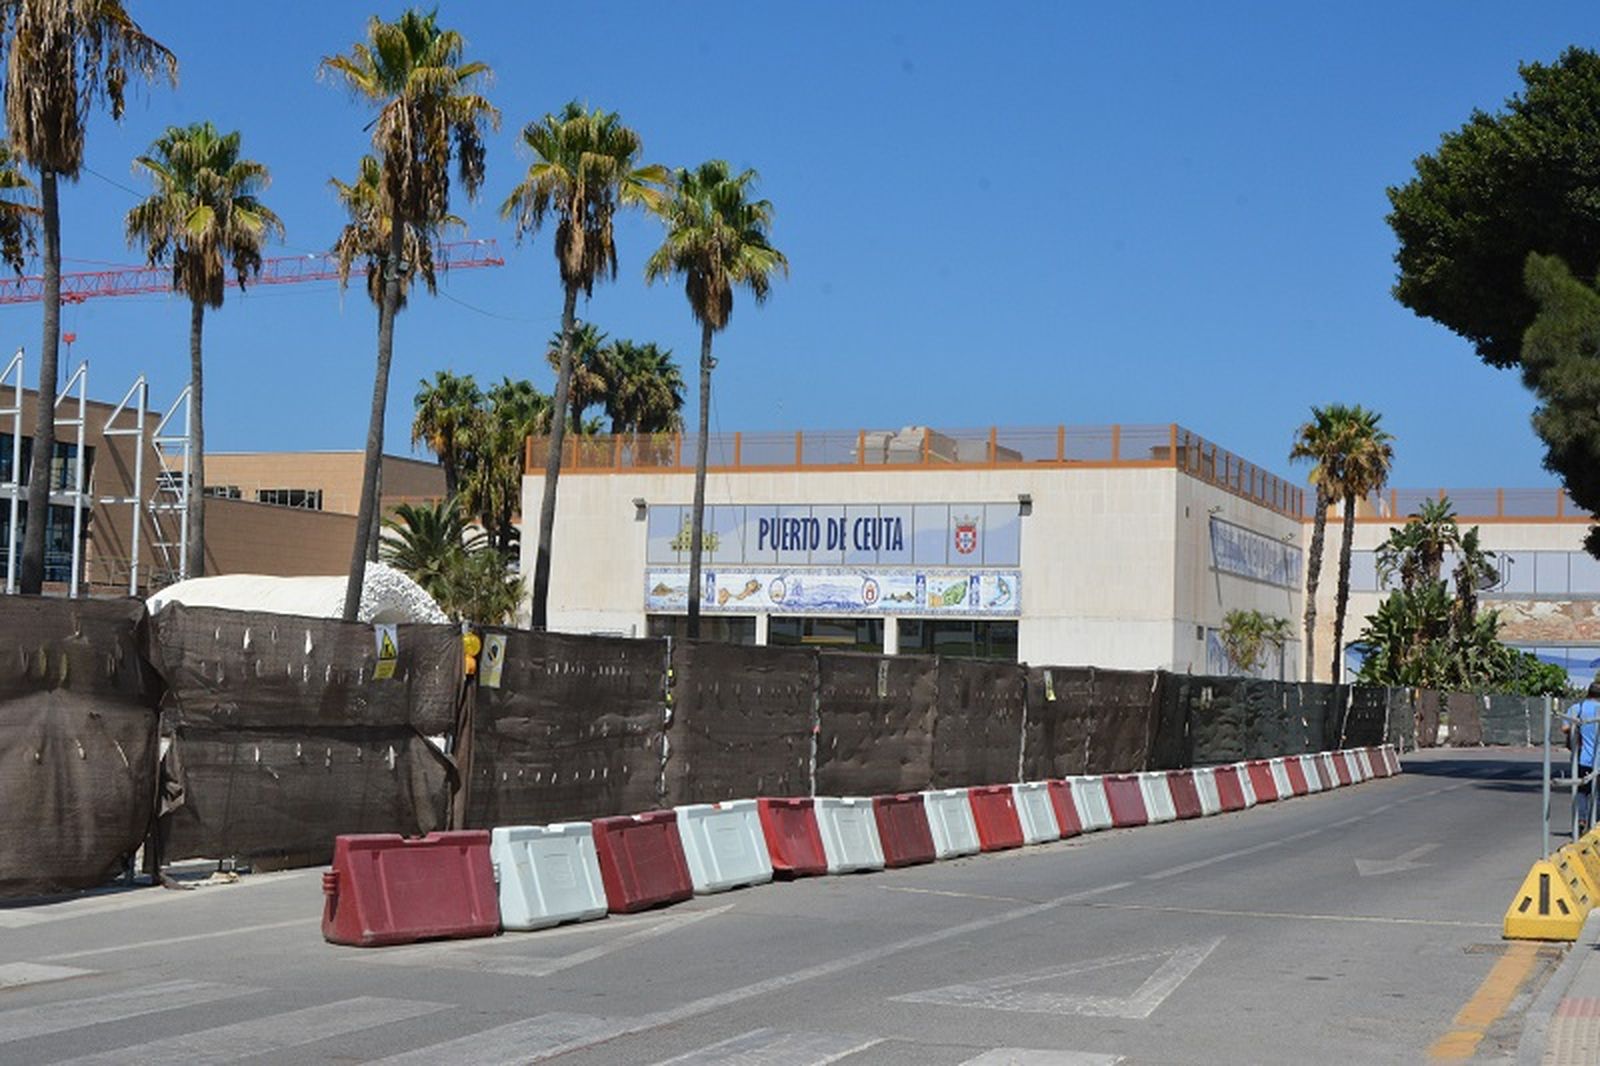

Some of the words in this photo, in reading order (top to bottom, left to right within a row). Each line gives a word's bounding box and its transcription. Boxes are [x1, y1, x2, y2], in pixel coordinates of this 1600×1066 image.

[758, 518, 820, 551] PUERTO
[827, 518, 847, 551] DE
[853, 517, 904, 551] CEUTA
